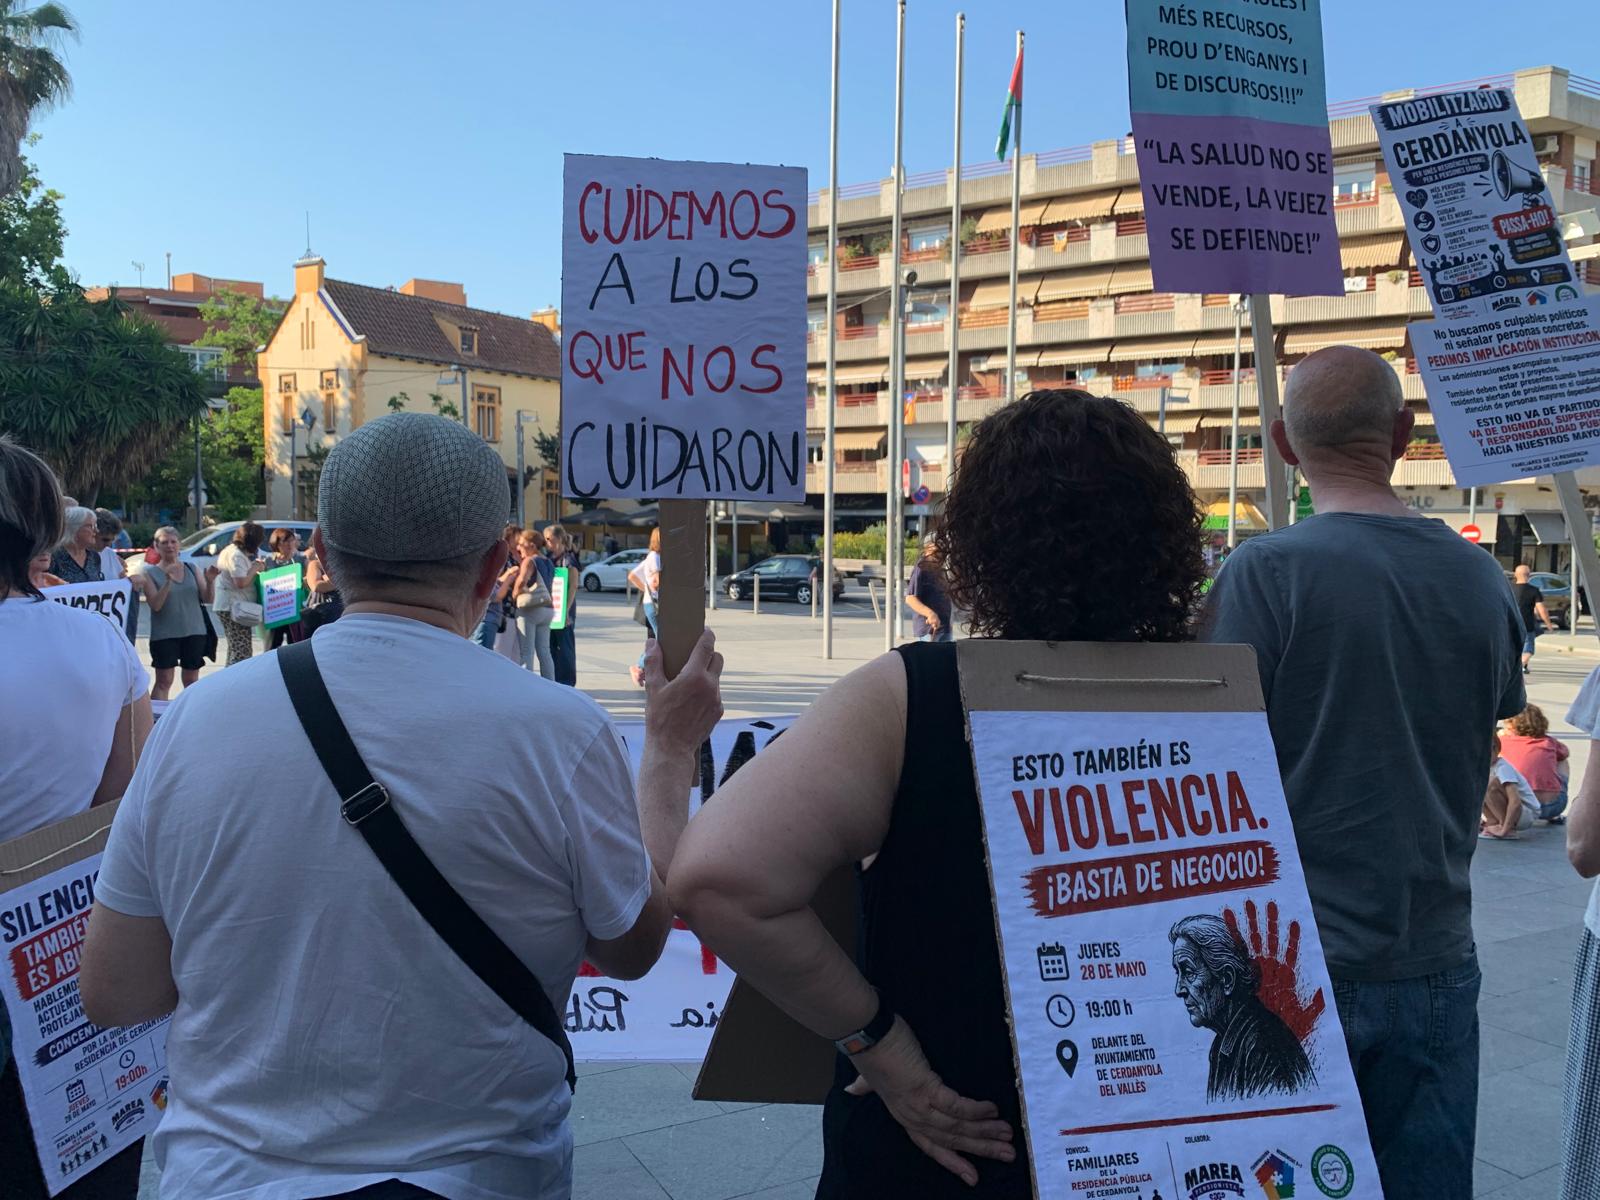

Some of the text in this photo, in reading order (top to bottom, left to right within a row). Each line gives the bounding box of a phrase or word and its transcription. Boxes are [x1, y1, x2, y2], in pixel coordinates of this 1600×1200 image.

[1159, 6, 1293, 44] MÉS RECURSOS,
[1147, 37, 1197, 59] PROU
[1303, 58, 1307, 75] I
[1155, 72, 1178, 90] DE
[1455, 118, 1463, 128] A
[1392, 121, 1528, 169] CERDANYOLA
[1191, 143, 1265, 167] SALUD
[1270, 148, 1300, 171] NO
[1306, 152, 1328, 174] SE
[1151, 184, 1328, 215] VENDE, LA VEJEZ
[1499, 209, 1551, 235] PASSA-HO!
[1170, 227, 1196, 250] SE
[589, 253, 758, 311] A LOS
[1433, 308, 1589, 339] No buscamos culpables políticos
[1444, 320, 1589, 350] ni señalar personas concretas.
[1427, 351, 1471, 367] PEDIMOS
[1472, 337, 1541, 361] IMPLICACIÓN
[1542, 330, 1600, 349] INSTITUCION
[569, 330, 783, 400] QUE NOS
[1452, 365, 1511, 381] administraciones
[1498, 372, 1519, 382] actos
[1446, 388, 1475, 399] También
[1476, 384, 1497, 394] deben
[1499, 381, 1518, 390] estar
[1520, 375, 1554, 388] presentes
[1485, 392, 1510, 402] alertan
[1511, 389, 1521, 397] de
[1476, 399, 1600, 428] ESTO NO VA DE PARTIDO
[1494, 402, 1503, 410] de
[1504, 397, 1538, 409] personas
[1469, 429, 1482, 438] VA
[1485, 427, 1498, 436] DE
[1501, 417, 1554, 433] DIGNIDAD,
[1476, 438, 1484, 447] Y
[1487, 423, 1577, 446] RESPONSABILIDAD
[1482, 428, 1600, 457] HACIA NUESTROS MAYO
[1012, 739, 1191, 781] ESTO TAMBIÉN ES
[1012, 771, 1268, 855] VIOLENCIA.
[1047, 847, 1265, 911] ¡BASTA DE NEGOCIO!
[0, 870, 99, 943] SILENCI
[1077, 942, 1121, 960] JUEVES
[27, 964, 50, 992] ES
[1080, 961, 1147, 981] 28 DE MAYO
[37, 992, 82, 1026] ACTUEMO
[1085, 999, 1133, 1018] 19:00 h
[74, 1041, 118, 1072] RESIDENCIA
[118, 1034, 129, 1046] DE
[82, 1041, 98, 1056] POR
[99, 1034, 108, 1047] LA
[1091, 1033, 1146, 1049] DELANTE DEL
[1094, 1048, 1156, 1065] AYUNTAMIENTO
[115, 1064, 148, 1091] 19:00h
[1096, 1064, 1163, 1081] DE CERDANYOLA
[1100, 1079, 1146, 1097] DEL VALLÈS
[111, 1098, 144, 1126] MAREA
[56, 1120, 97, 1149] FAMILIARES
[1068, 1152, 1139, 1171] FAMILIARES
[1100, 1168, 1118, 1177] DE LA
[1071, 1173, 1152, 1190] RESIDENCIA PÚBLICA
[1184, 1163, 1243, 1191] MAREA
[1086, 1185, 1141, 1199] DE CERDANYOLA
